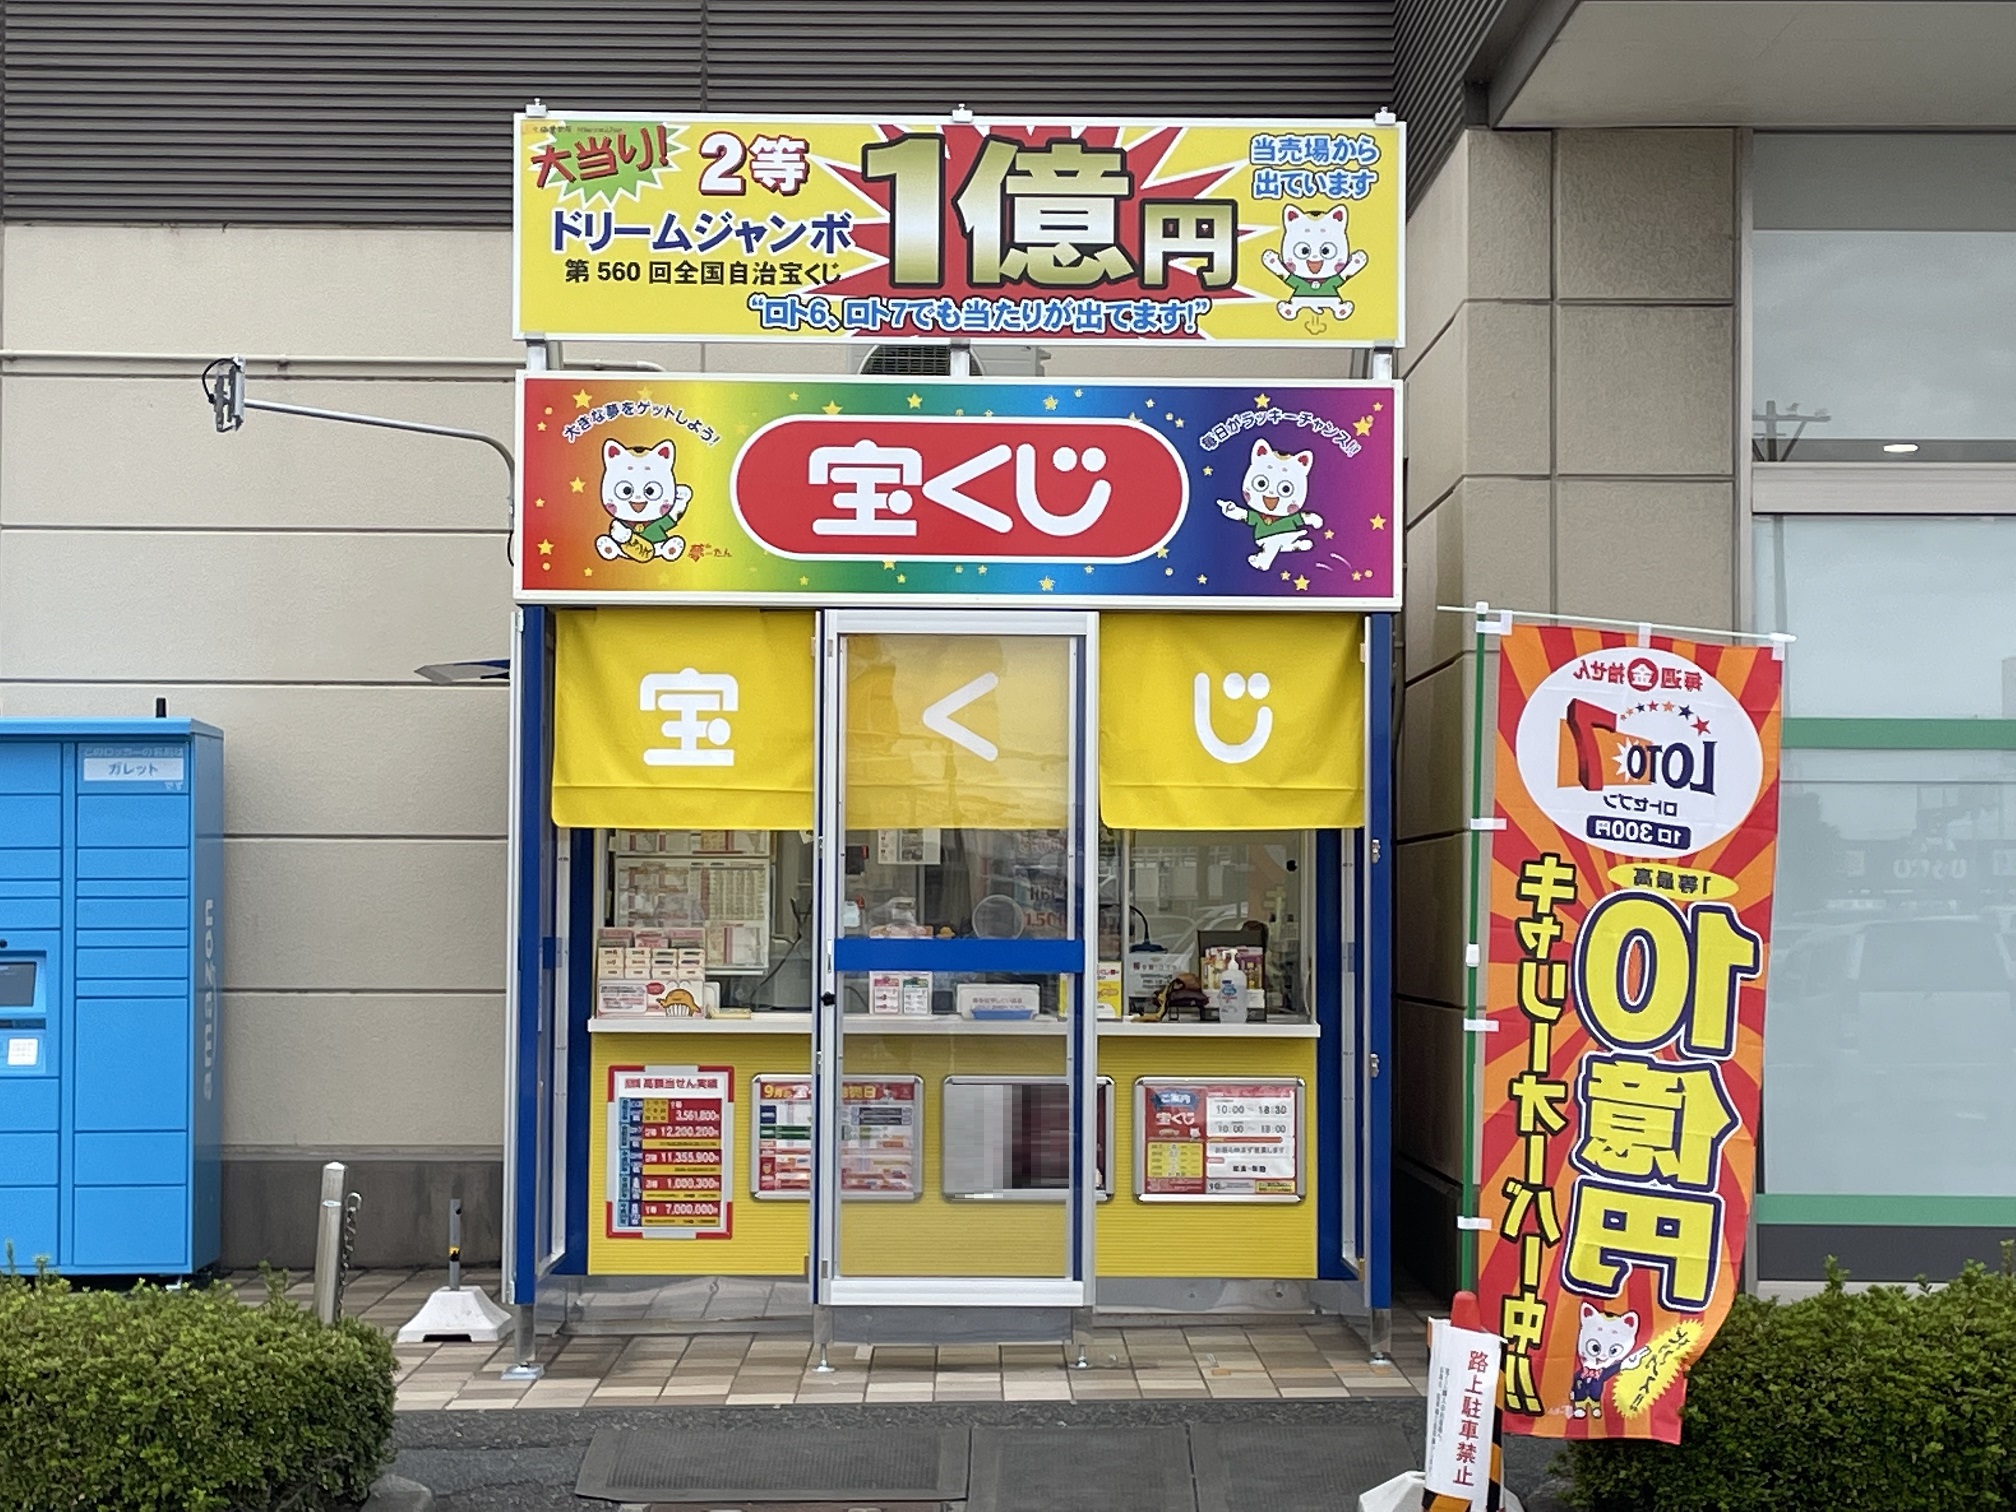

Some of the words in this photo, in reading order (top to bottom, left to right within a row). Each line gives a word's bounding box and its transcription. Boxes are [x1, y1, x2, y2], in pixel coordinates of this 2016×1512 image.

[530, 124, 669, 189] 大当り!
[699, 131, 810, 196] 2等
[1250, 133, 1381, 165] 当売場から
[861, 133, 1239, 289] 1億円
[1252, 166, 1379, 199] 出ています
[553, 210, 853, 254] ドリームジャンボ
[562, 400, 721, 447] 大きな夢をゲットしよう!
[809, 440, 1111, 537] 宝くじ
[639, 667, 740, 768] 宝
[922, 671, 999, 763] く
[1194, 671, 1273, 765] じ
[108, 761, 159, 776] ガレット
[202, 899, 216, 1101] amazon
[1155, 1112, 1195, 1126] 宝くじ
[1452, 1349, 1490, 1487] 路上駐車禁止
